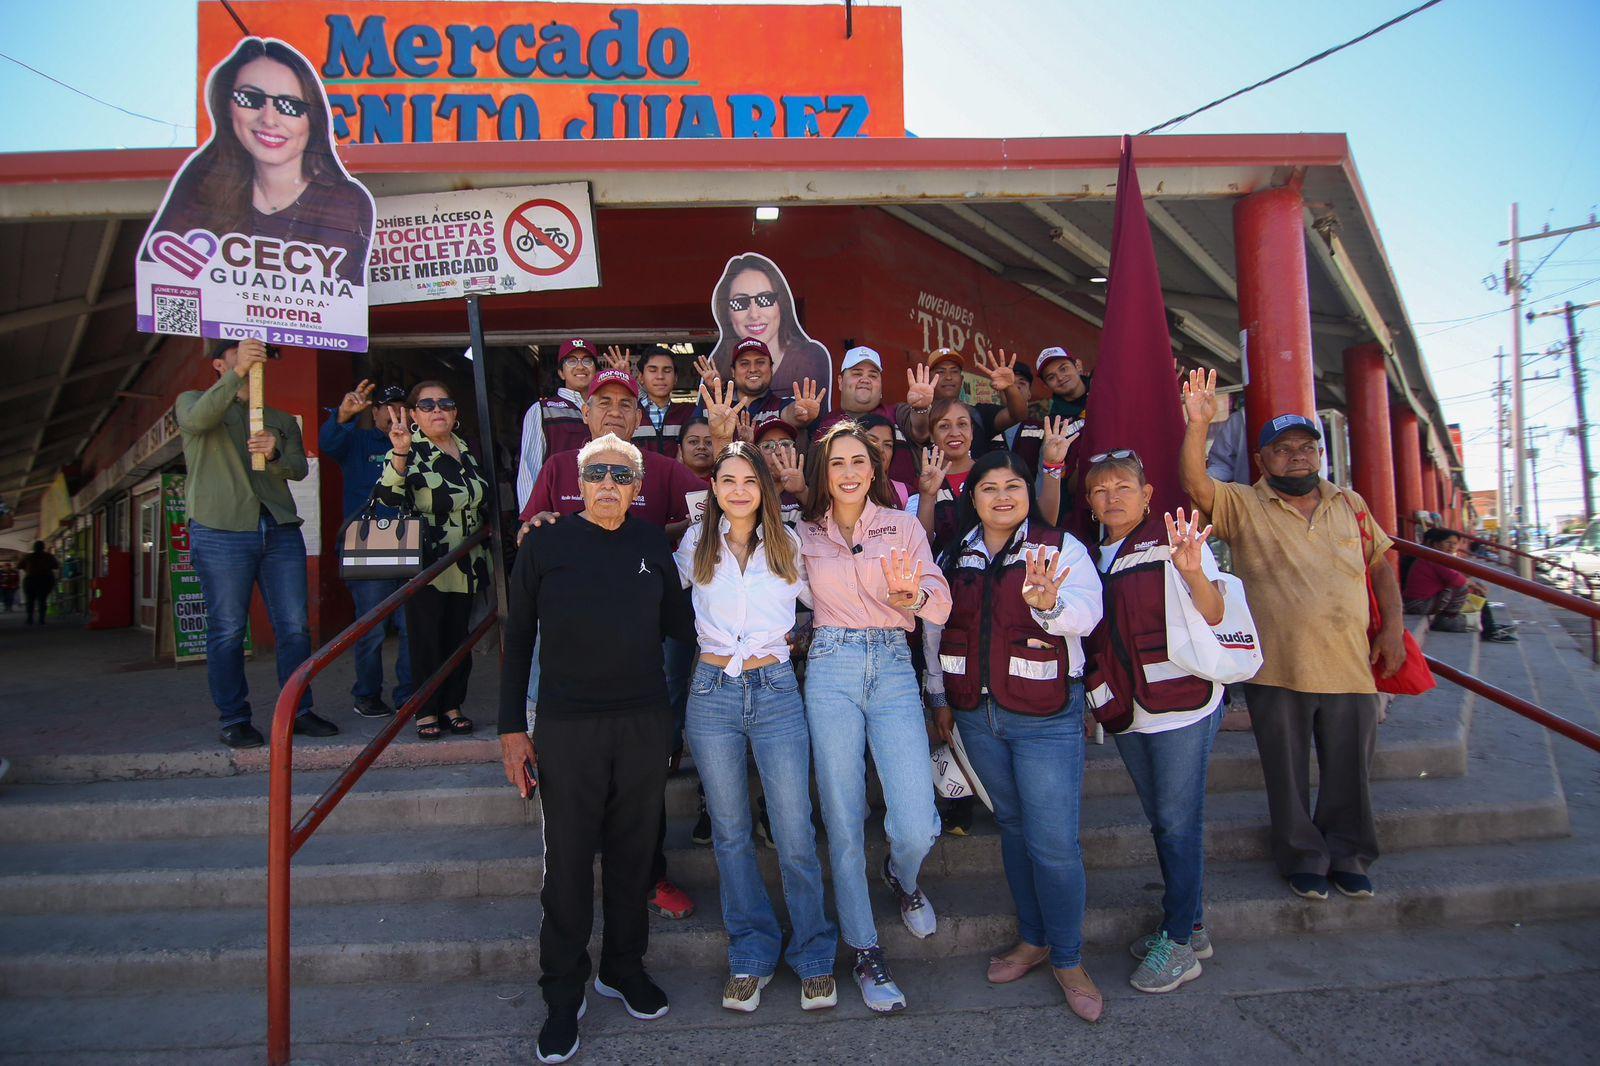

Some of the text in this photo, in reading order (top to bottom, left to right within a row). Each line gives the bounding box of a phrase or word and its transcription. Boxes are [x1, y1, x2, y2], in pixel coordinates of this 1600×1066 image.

[322, 8, 690, 79] Mercado
[328, 93, 870, 145] ENITO JUAREZ
[376, 209, 493, 229] OHÍBE EL ACCESO A
[375, 221, 495, 246] TOCICLETAS
[221, 236, 343, 279] CECY
[369, 238, 497, 267] BICICLETAS
[210, 267, 354, 299] GUADIANA
[370, 256, 499, 283] ESTE MERCADO
[246, 304, 323, 324] morena
[918, 291, 974, 327] NOVEDADES
[223, 326, 349, 349] VOTA 2 DE JUNIO
[868, 525, 898, 537] morena
[1214, 630, 1254, 644] audia
